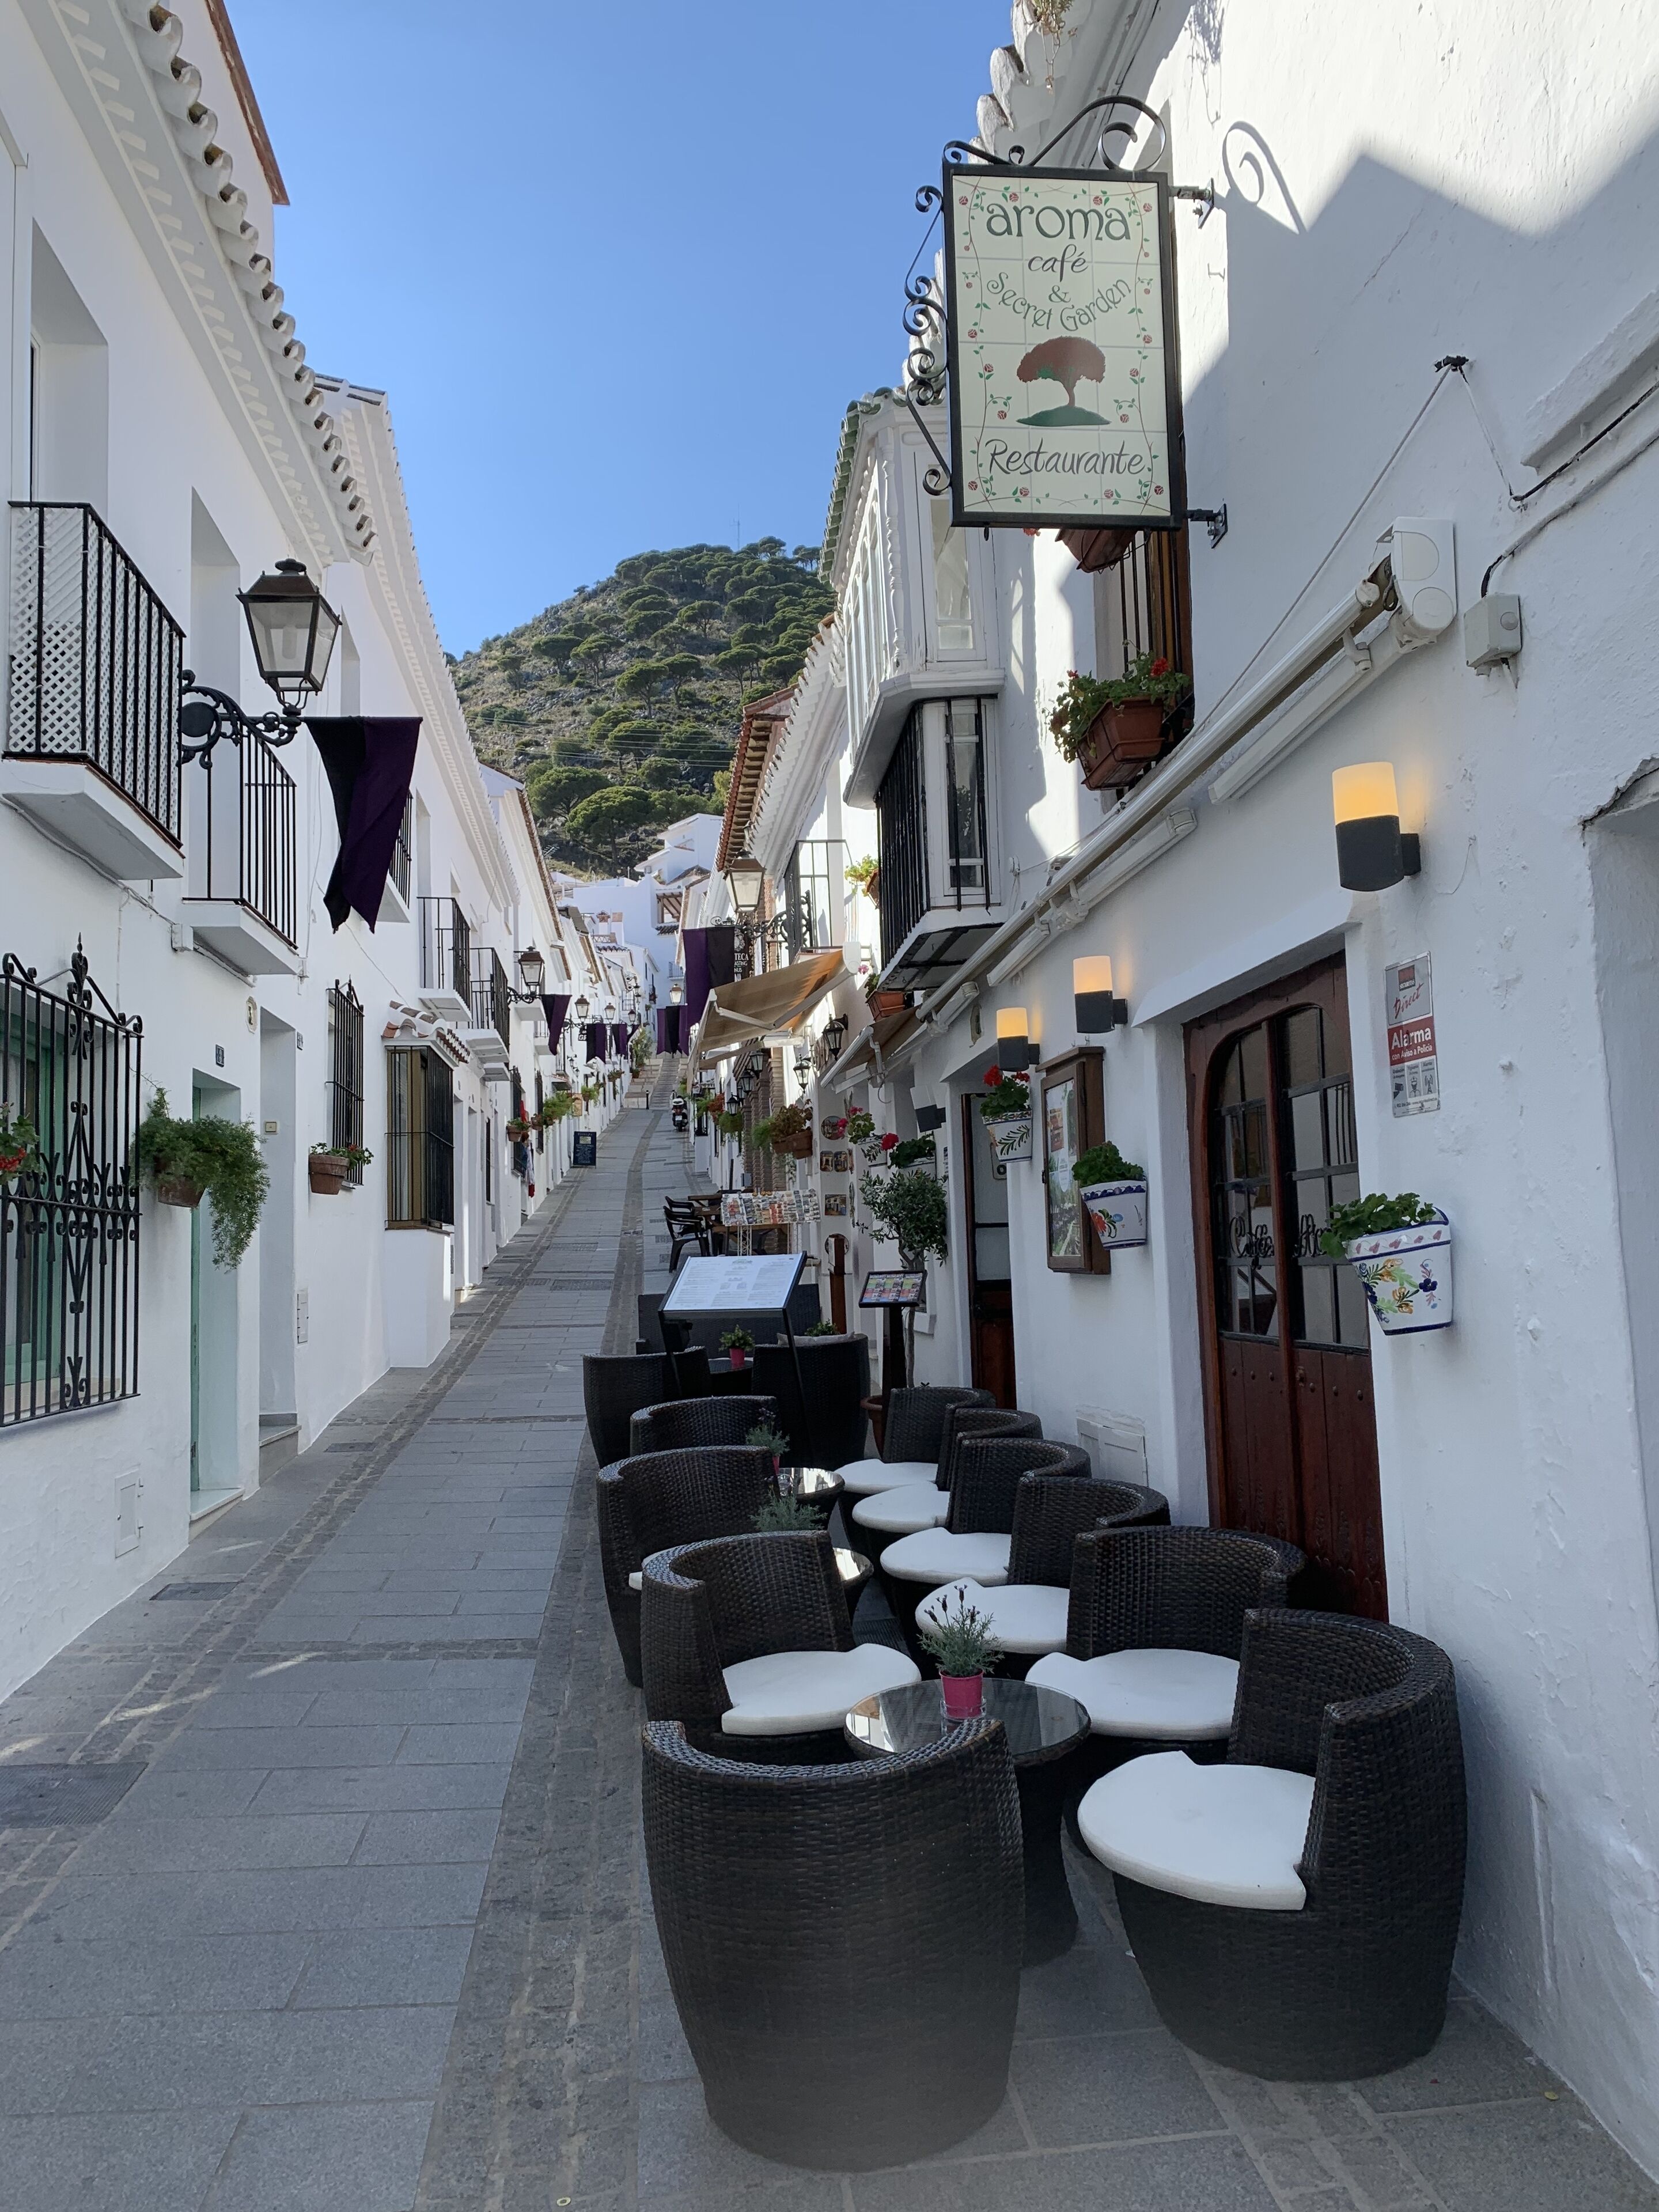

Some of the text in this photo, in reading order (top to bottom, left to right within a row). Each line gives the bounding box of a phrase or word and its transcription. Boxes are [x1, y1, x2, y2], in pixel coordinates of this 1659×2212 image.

[986, 203, 1131, 241] aroma
[1028, 244, 1088, 282] café
[986, 271, 1132, 332] Secret Garden
[1048, 285, 1071, 303] &
[985, 438, 1145, 475] Restaurante
[734, 953, 749, 961] TECA
[1393, 982, 1425, 1019] Direct
[1391, 1027, 1432, 1050] Alarma
[1401, 1048, 1413, 1058] Aviso
